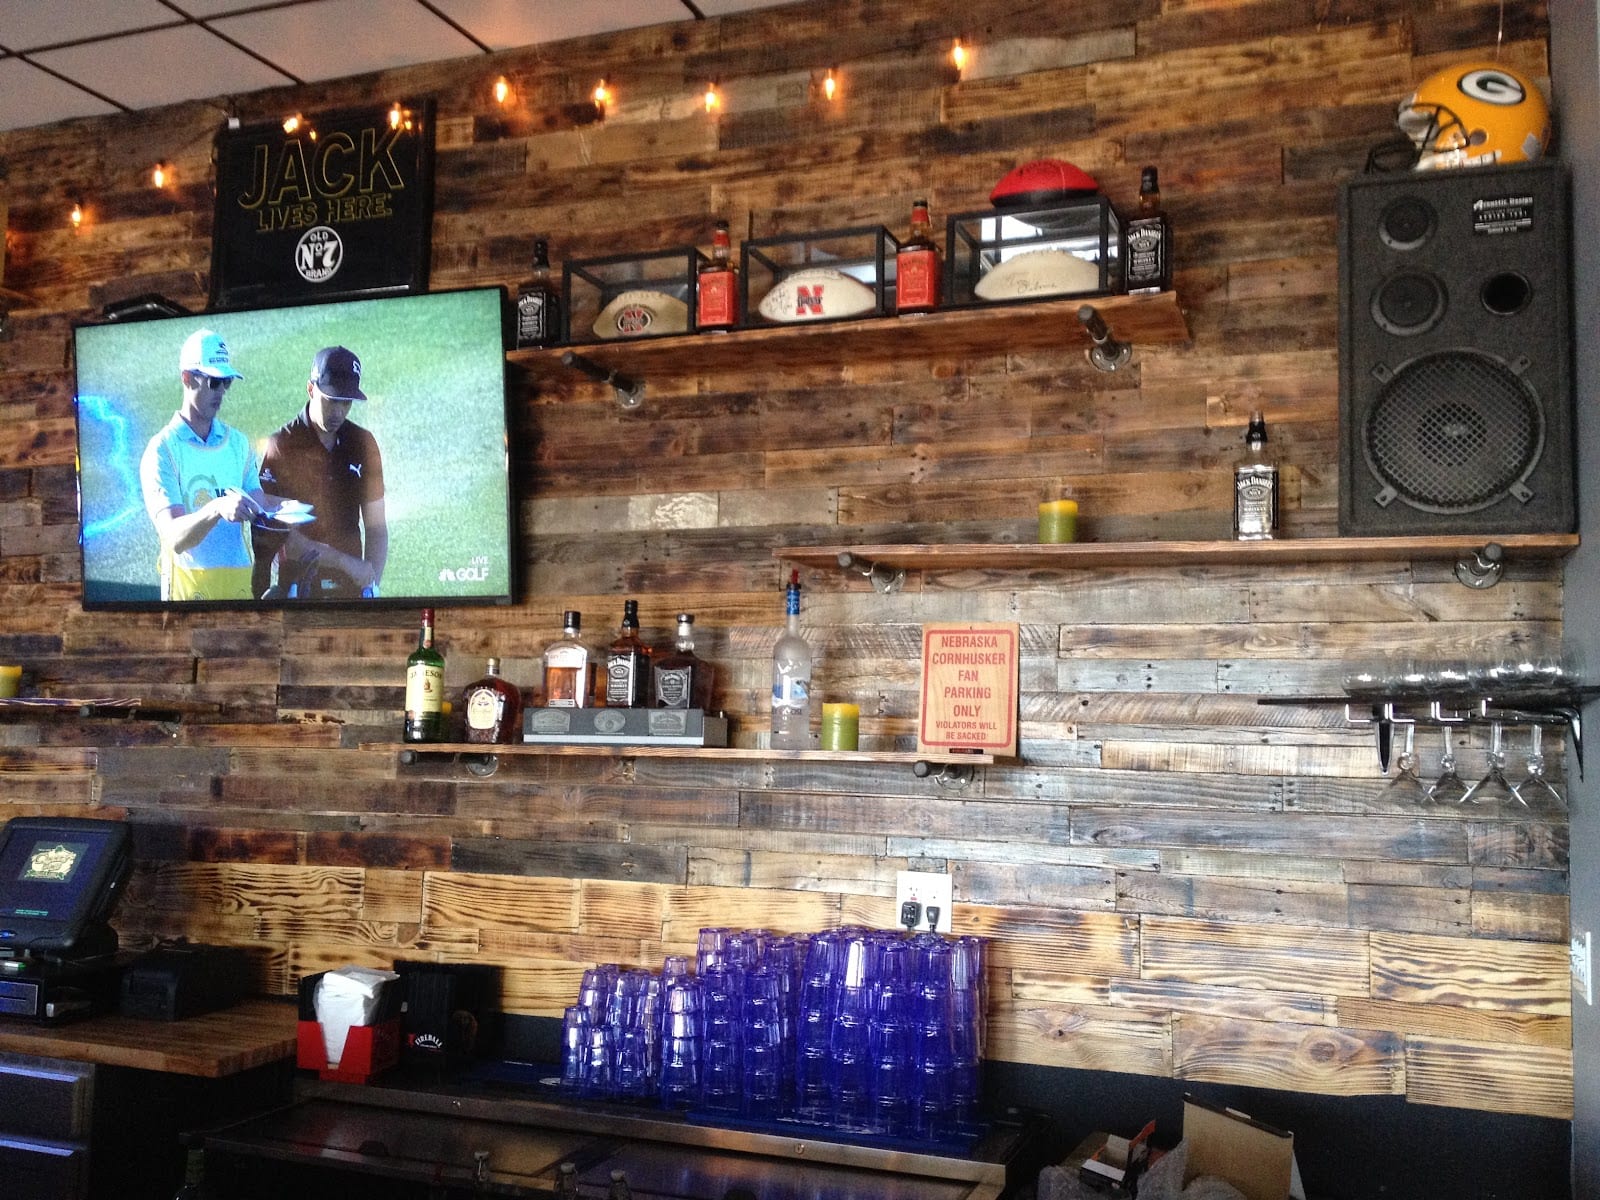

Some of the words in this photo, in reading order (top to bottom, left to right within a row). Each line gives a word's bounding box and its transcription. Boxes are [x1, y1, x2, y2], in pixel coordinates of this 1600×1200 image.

[1457, 68, 1527, 106] G
[237, 127, 405, 210] JACK
[256, 201, 319, 233] LIVES
[310, 230, 329, 242] OLD
[305, 266, 332, 279] BRAND
[796, 285, 824, 316] N
[471, 555, 489, 565] LIVE
[455, 567, 489, 582] GOLF
[941, 635, 998, 648] NEBRASKA
[932, 652, 1006, 665] CORNHUSKER
[958, 670, 979, 682] FAN
[944, 687, 991, 699] PARKING
[953, 704, 982, 718] ONLY
[935, 720, 977, 730] VIOLATORS
[979, 721, 997, 730] WILL
[945, 731, 956, 740] BE
[414, 1033, 444, 1048] FIREBALL
